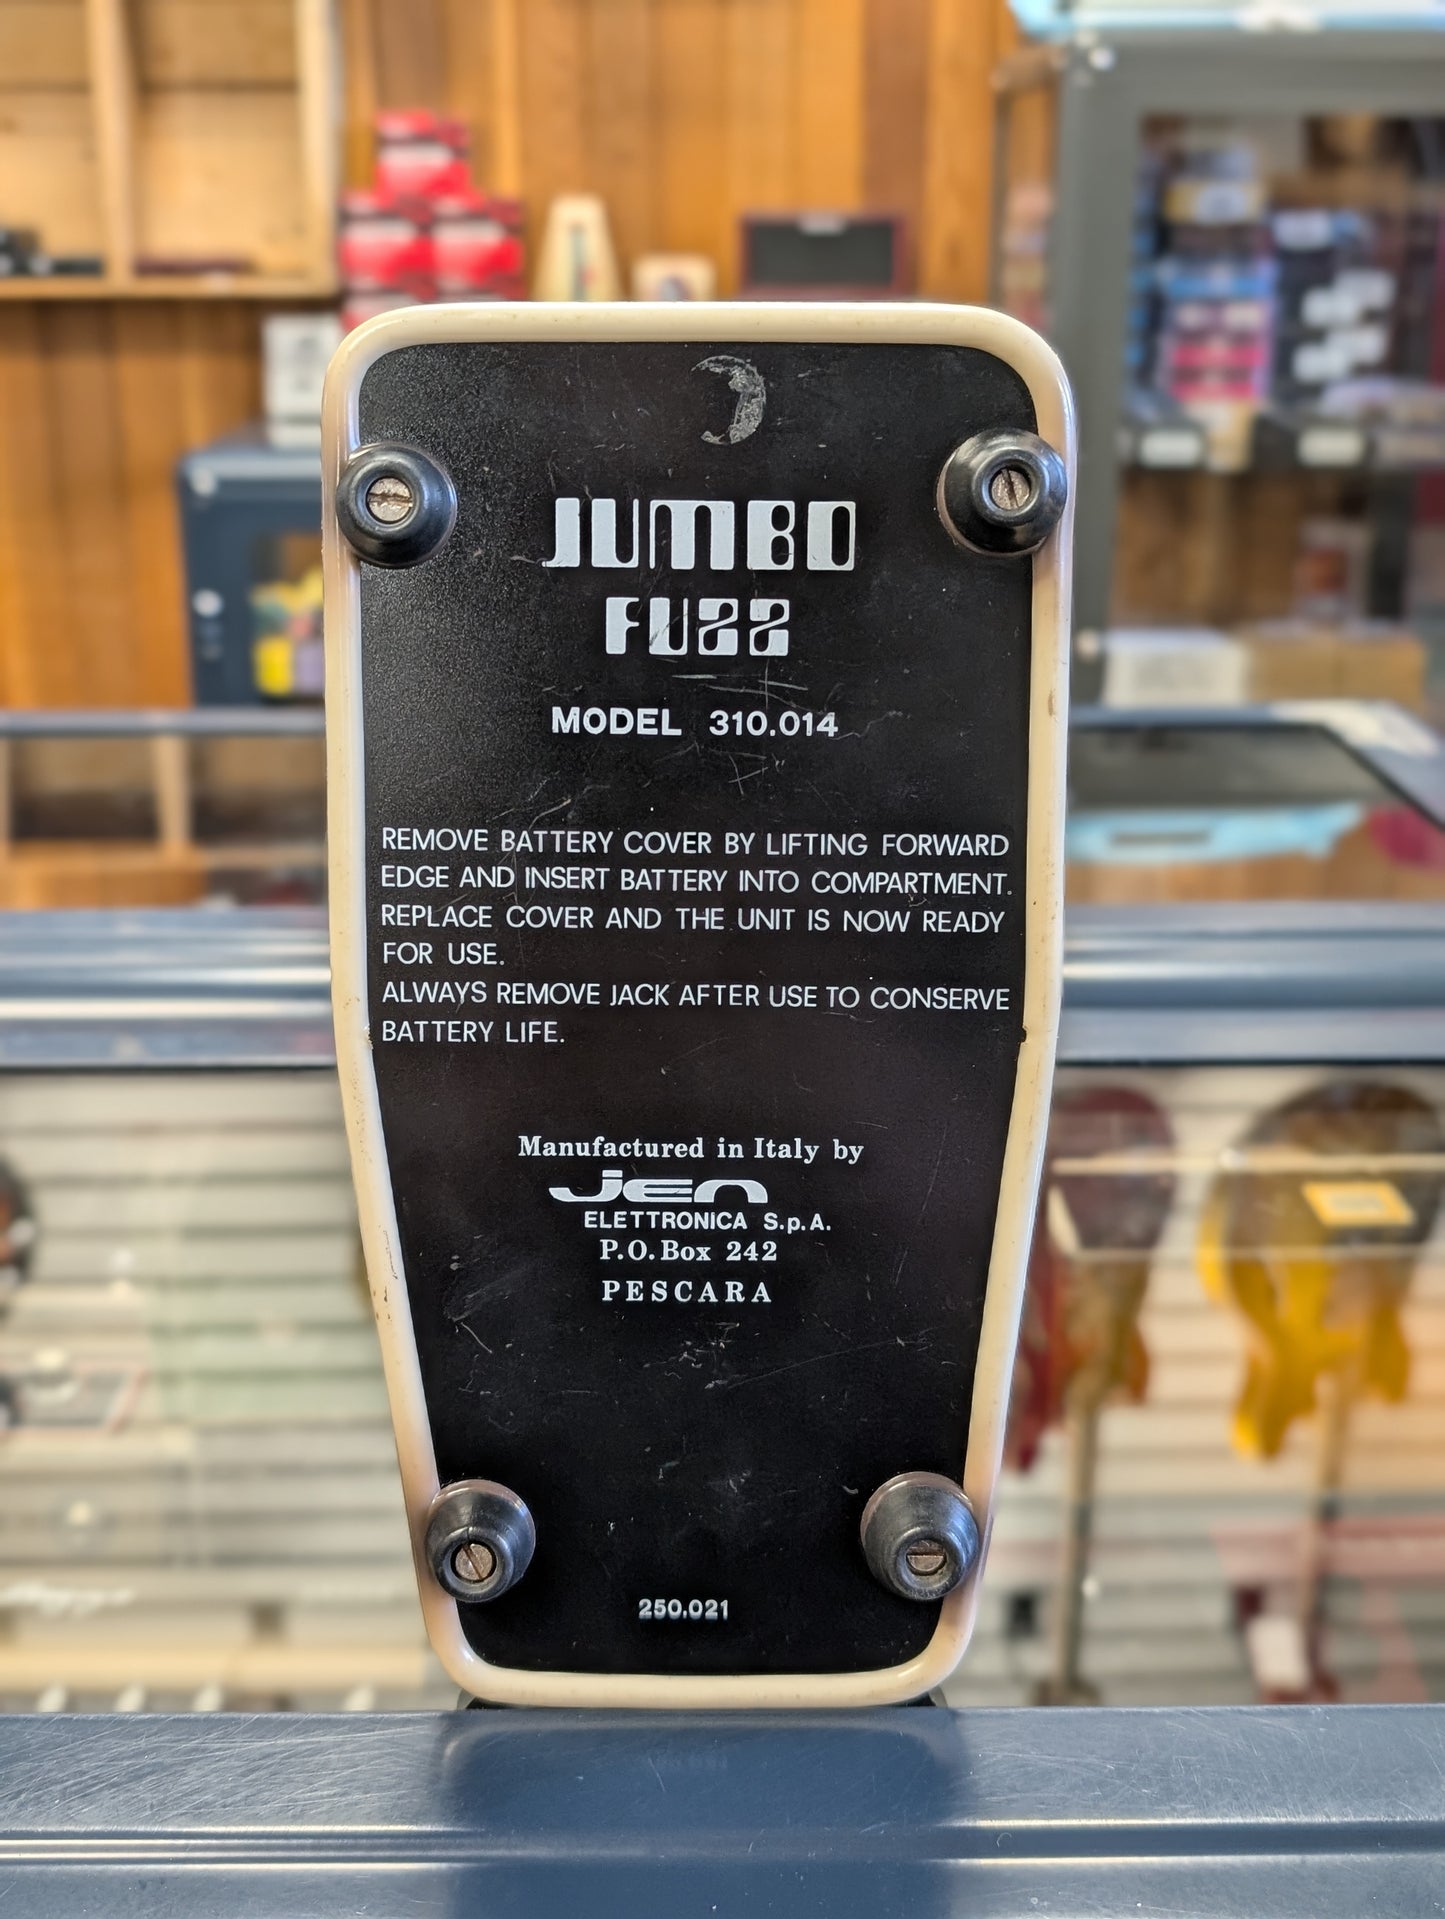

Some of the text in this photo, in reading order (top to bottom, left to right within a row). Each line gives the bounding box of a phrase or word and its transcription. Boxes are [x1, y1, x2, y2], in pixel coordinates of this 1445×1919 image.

[541, 497, 857, 571] JUMBO
[605, 596, 790, 657] FUZZ
[551, 706, 839, 738] MODEL 310.014
[382, 826, 1010, 857] REMOVE BATTERY COVER BY LIFTING FORWARD
[381, 864, 1012, 896] EDGE AND INSERT BATTERY INTO COMPARTMENT.
[381, 903, 1006, 933] REPLACE COVER AND THE UNIT IS NOW READY
[383, 941, 505, 966] FOR USE.
[382, 980, 1010, 1011] ALWAYS REMOVE JACK AFTER USE TO CONSERVE
[382, 1020, 565, 1043] BATTERY LIFE.
[518, 1135, 865, 1165] Manufactured in Italy by
[584, 1210, 831, 1235] ELETTRONICA S.p.A.
[725, 1240, 777, 1262] 242
[601, 1280, 772, 1303] PESCARA
[638, 1598, 728, 1619] 250.021
